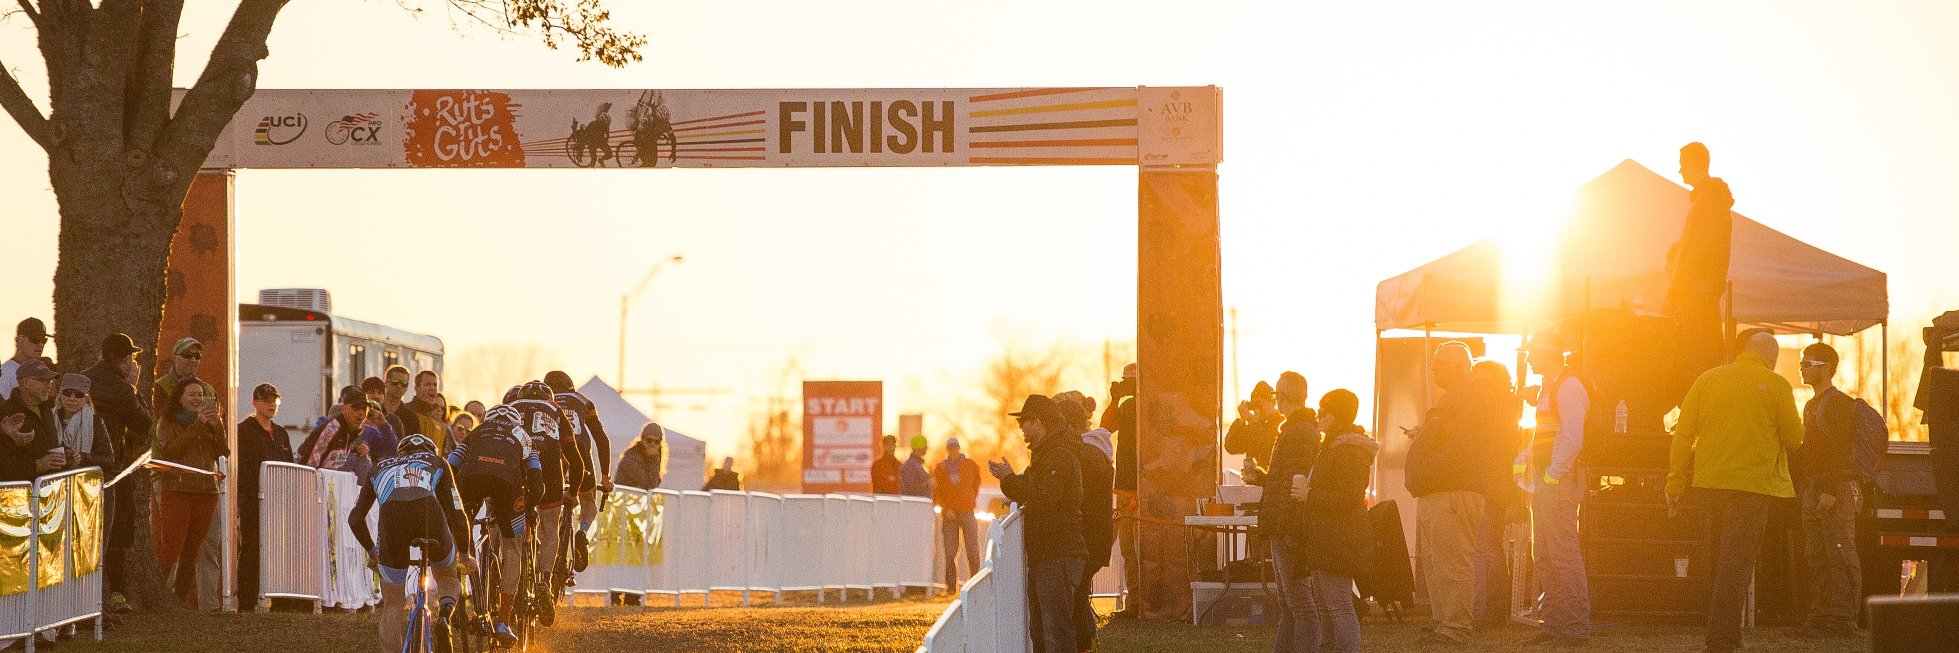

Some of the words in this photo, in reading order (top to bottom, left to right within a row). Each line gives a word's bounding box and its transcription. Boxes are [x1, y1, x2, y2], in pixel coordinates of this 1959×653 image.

[436, 94, 495, 126] Ruts
[1162, 102, 1193, 115] AVB
[351, 127, 382, 142] CX
[779, 99, 955, 154] FINISH
[434, 125, 503, 161] Guts
[805, 397, 878, 415] START
